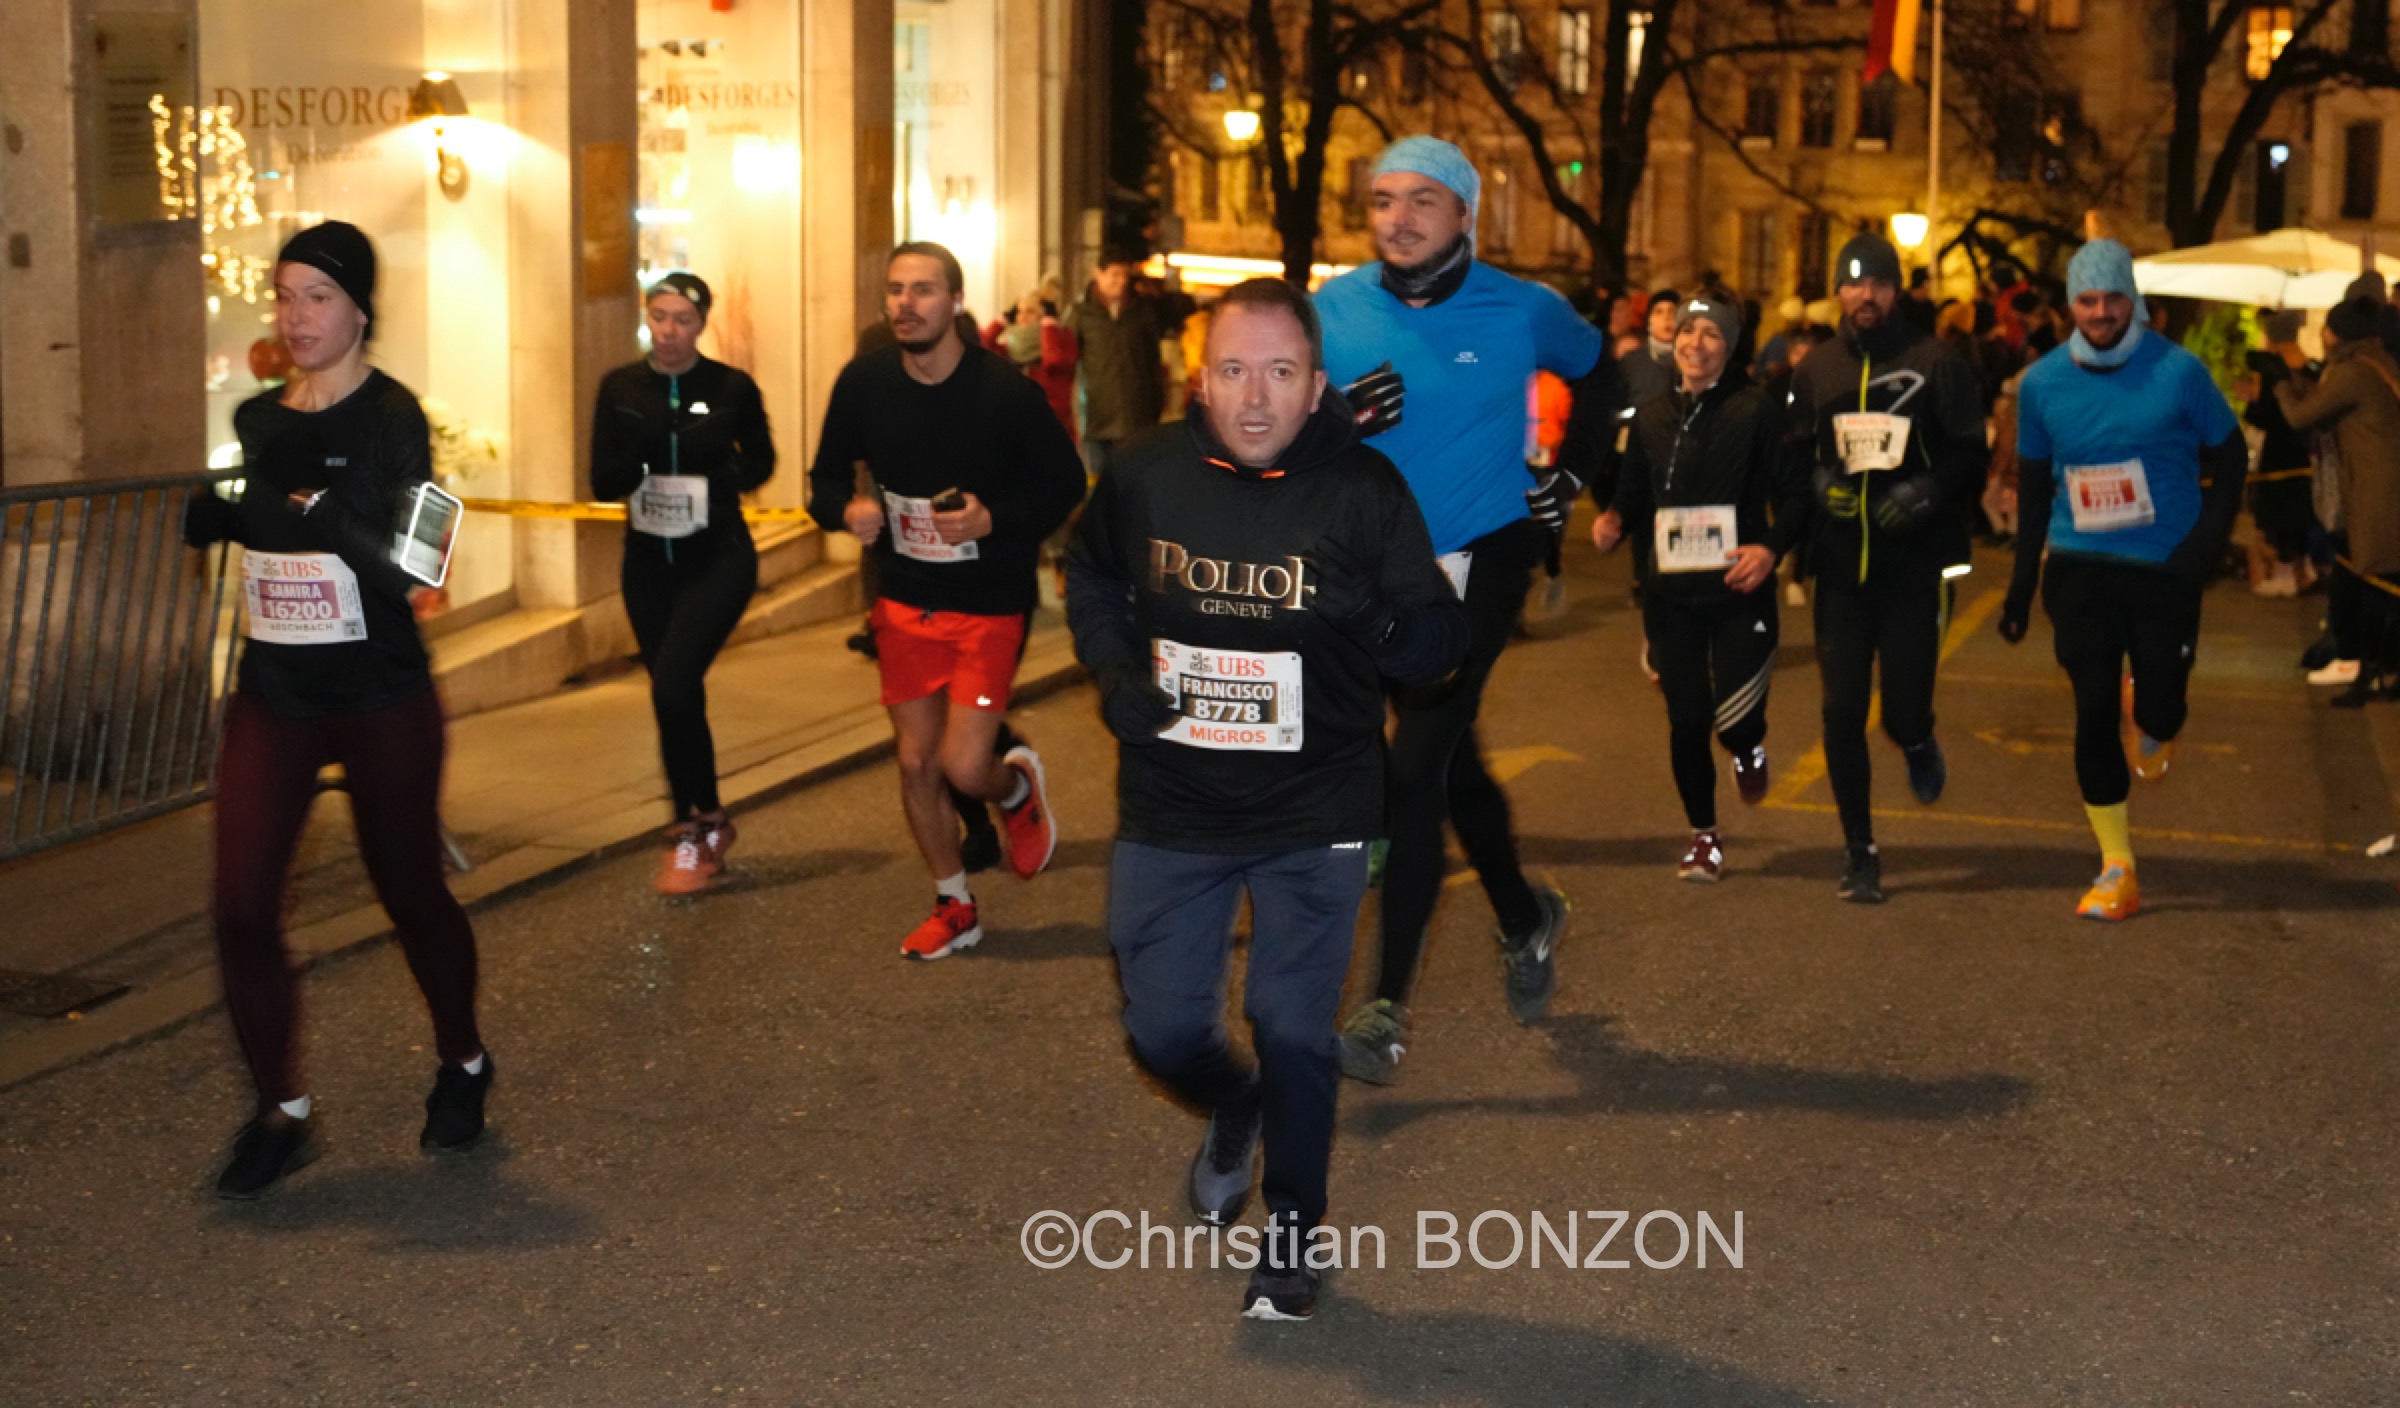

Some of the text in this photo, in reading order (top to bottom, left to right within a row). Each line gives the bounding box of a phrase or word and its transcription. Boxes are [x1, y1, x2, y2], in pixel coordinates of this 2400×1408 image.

[213, 86, 418, 129] DESFORG
[282, 560, 324, 579] UBS
[268, 583, 323, 599] SAMIRA
[264, 600, 333, 619] 16200
[1216, 656, 1266, 677] UBS
[1183, 677, 1274, 701] FRANCISCO
[1194, 698, 1262, 723] 8778
[1190, 725, 1268, 743] MIGROS
